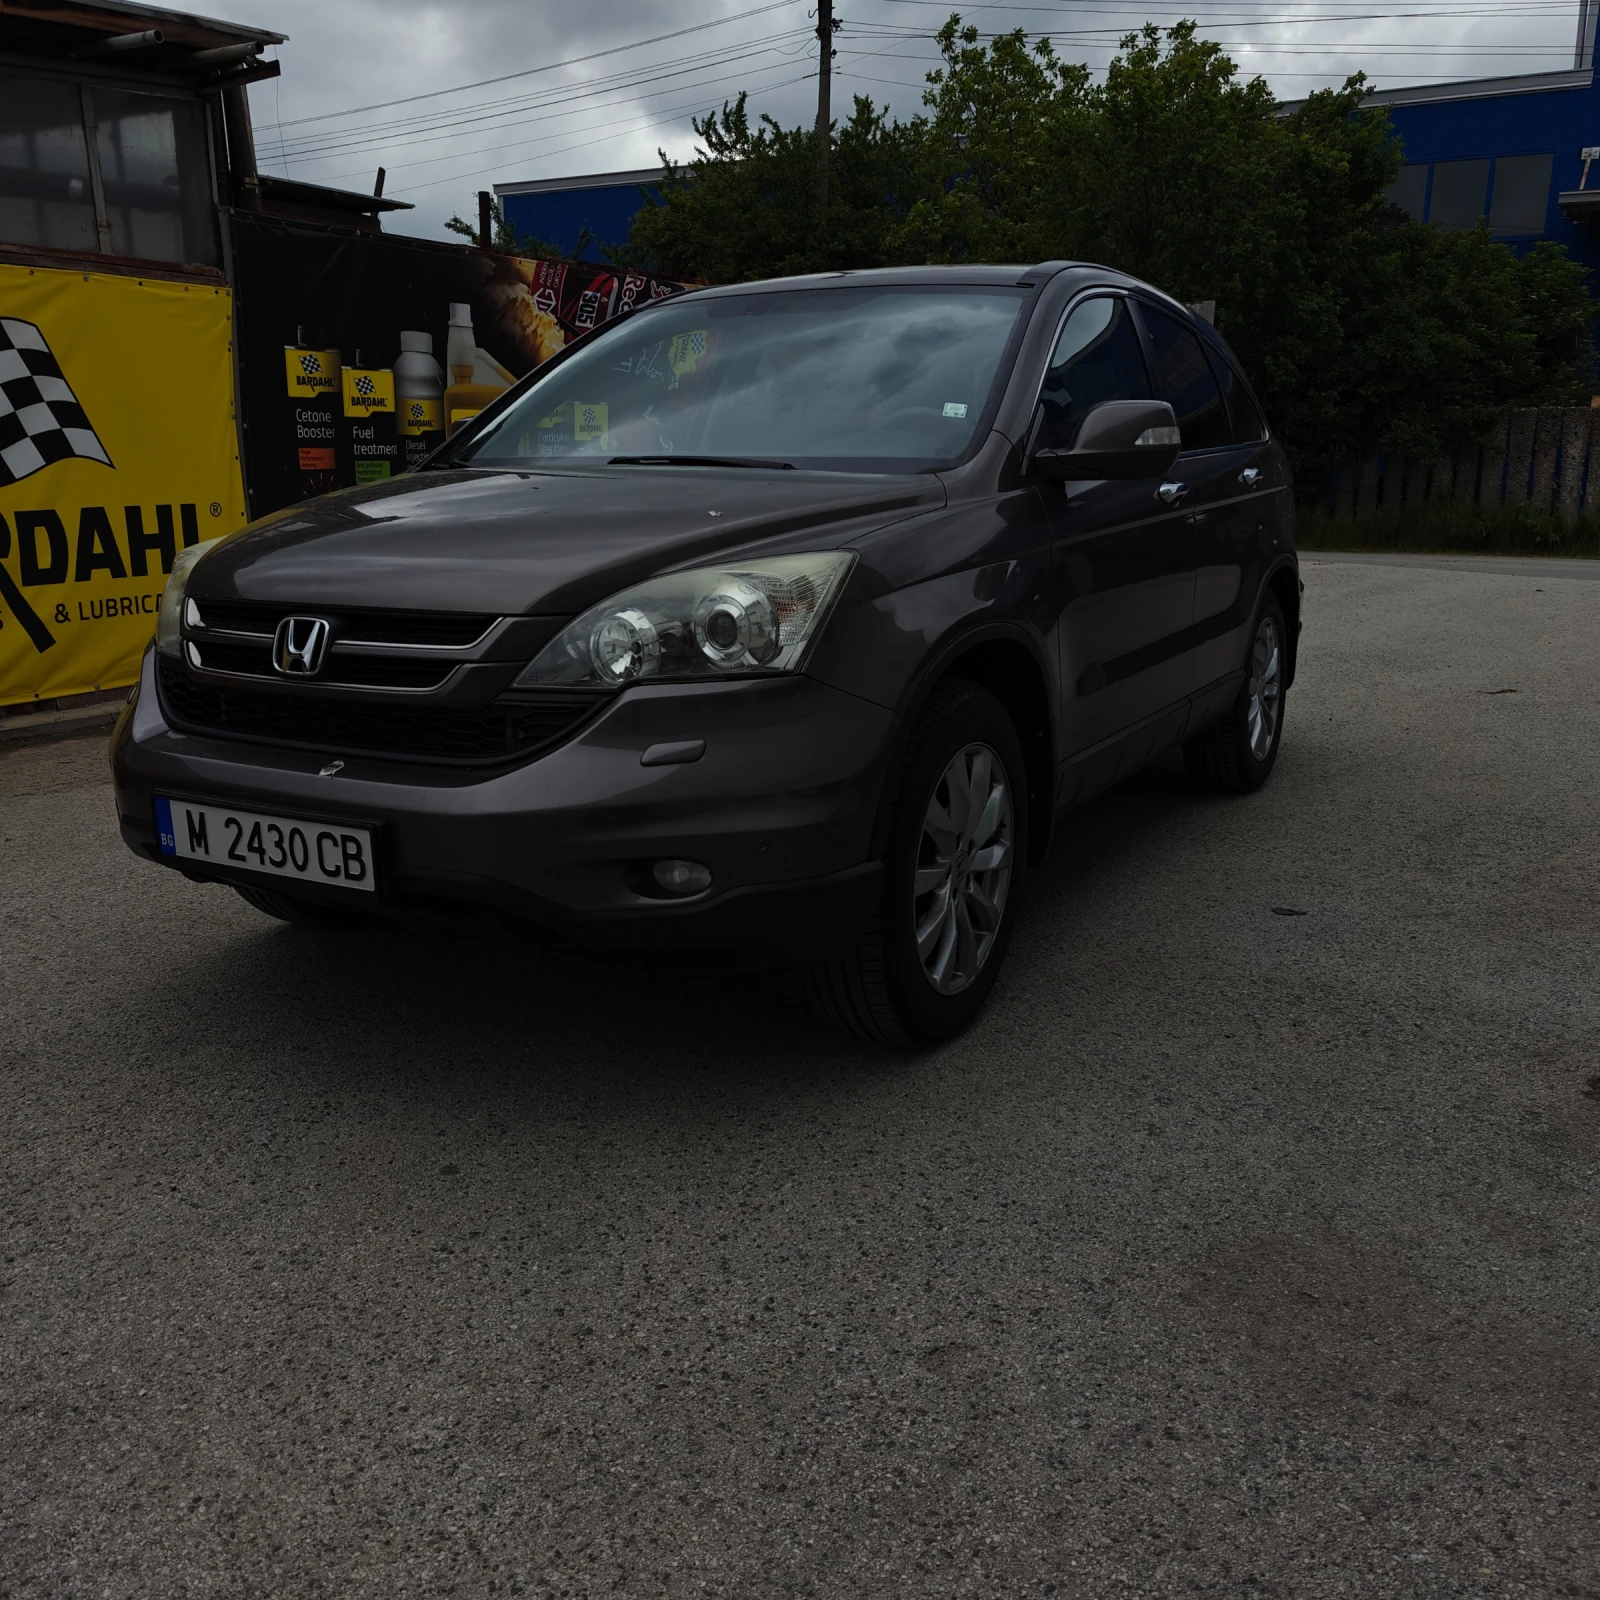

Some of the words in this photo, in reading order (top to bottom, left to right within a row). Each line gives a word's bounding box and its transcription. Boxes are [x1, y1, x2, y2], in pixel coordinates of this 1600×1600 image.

[578, 293, 599, 325] 305
[296, 376, 335, 389] BARDAHL
[351, 397, 388, 409] BARDAHL
[296, 408, 332, 423] Cetane
[297, 424, 336, 439] Booster
[407, 419, 435, 430] BARDAHL
[353, 426, 374, 439] Fuel
[353, 443, 399, 455] treatment
[405, 440, 426, 451] Diesel
[0, 503, 200, 588] DAH
[54, 603, 71, 624] &
[160, 832, 174, 847] BG
[186, 809, 209, 855] M
